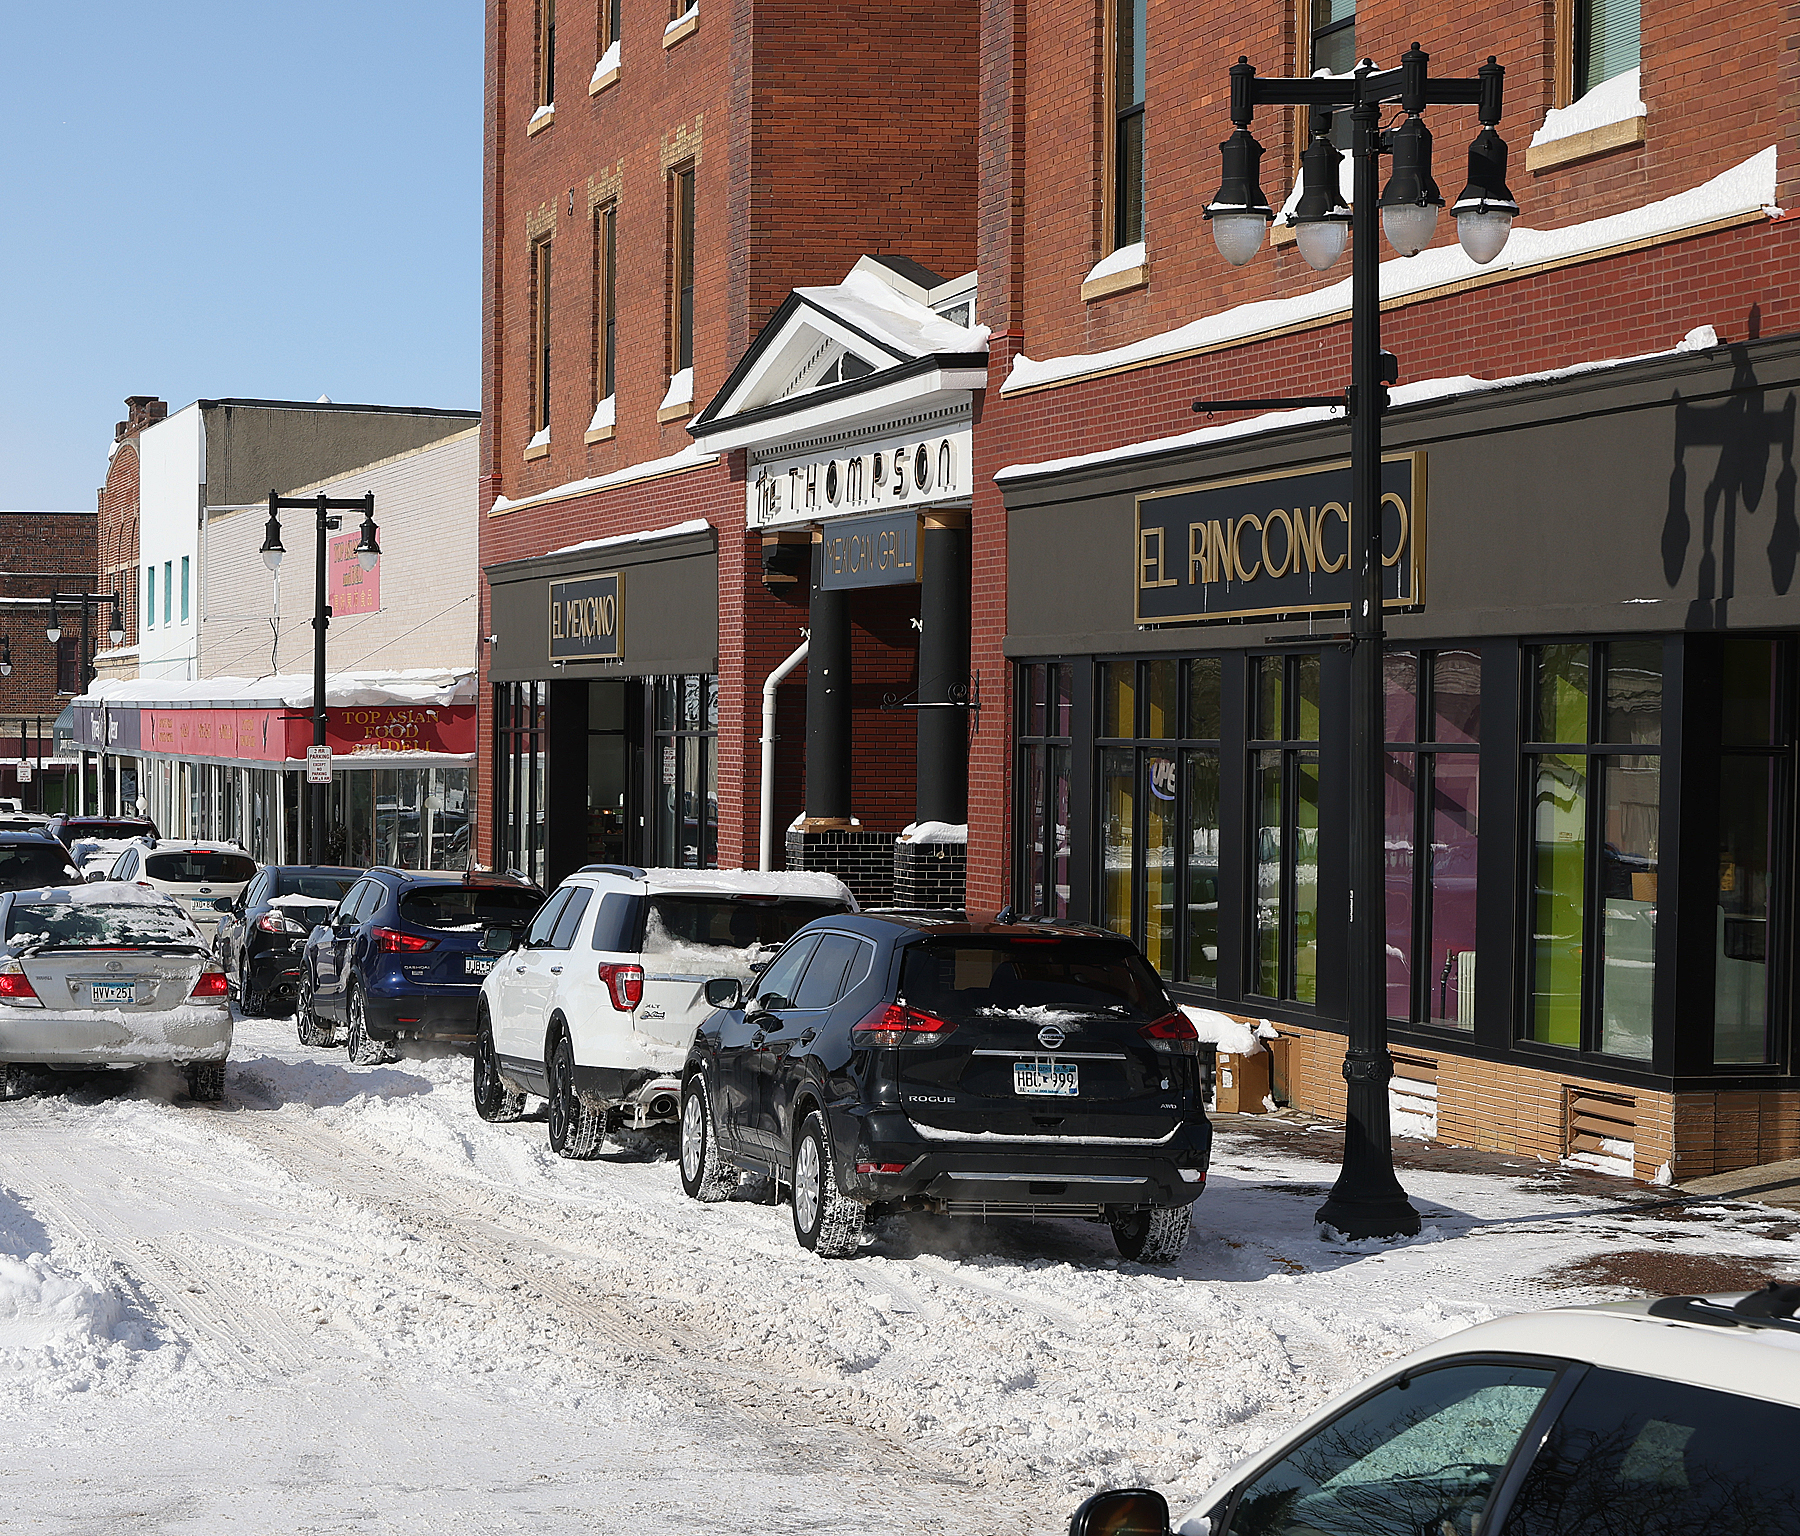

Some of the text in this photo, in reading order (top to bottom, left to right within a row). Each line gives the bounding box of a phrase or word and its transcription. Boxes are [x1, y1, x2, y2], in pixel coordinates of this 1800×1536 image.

[789, 439, 954, 510] THOMPSON
[825, 529, 912, 575] MEXICAN GRILL
[1140, 526, 1178, 590] EL
[552, 594, 616, 639] EL MEXICANO
[341, 710, 440, 725] TOP ASIAN
[364, 724, 419, 739] FOOD
[116, 987, 133, 999] 251
[1017, 1070, 1074, 1088] HBC 999
[908, 1095, 956, 1103] ROGUE
